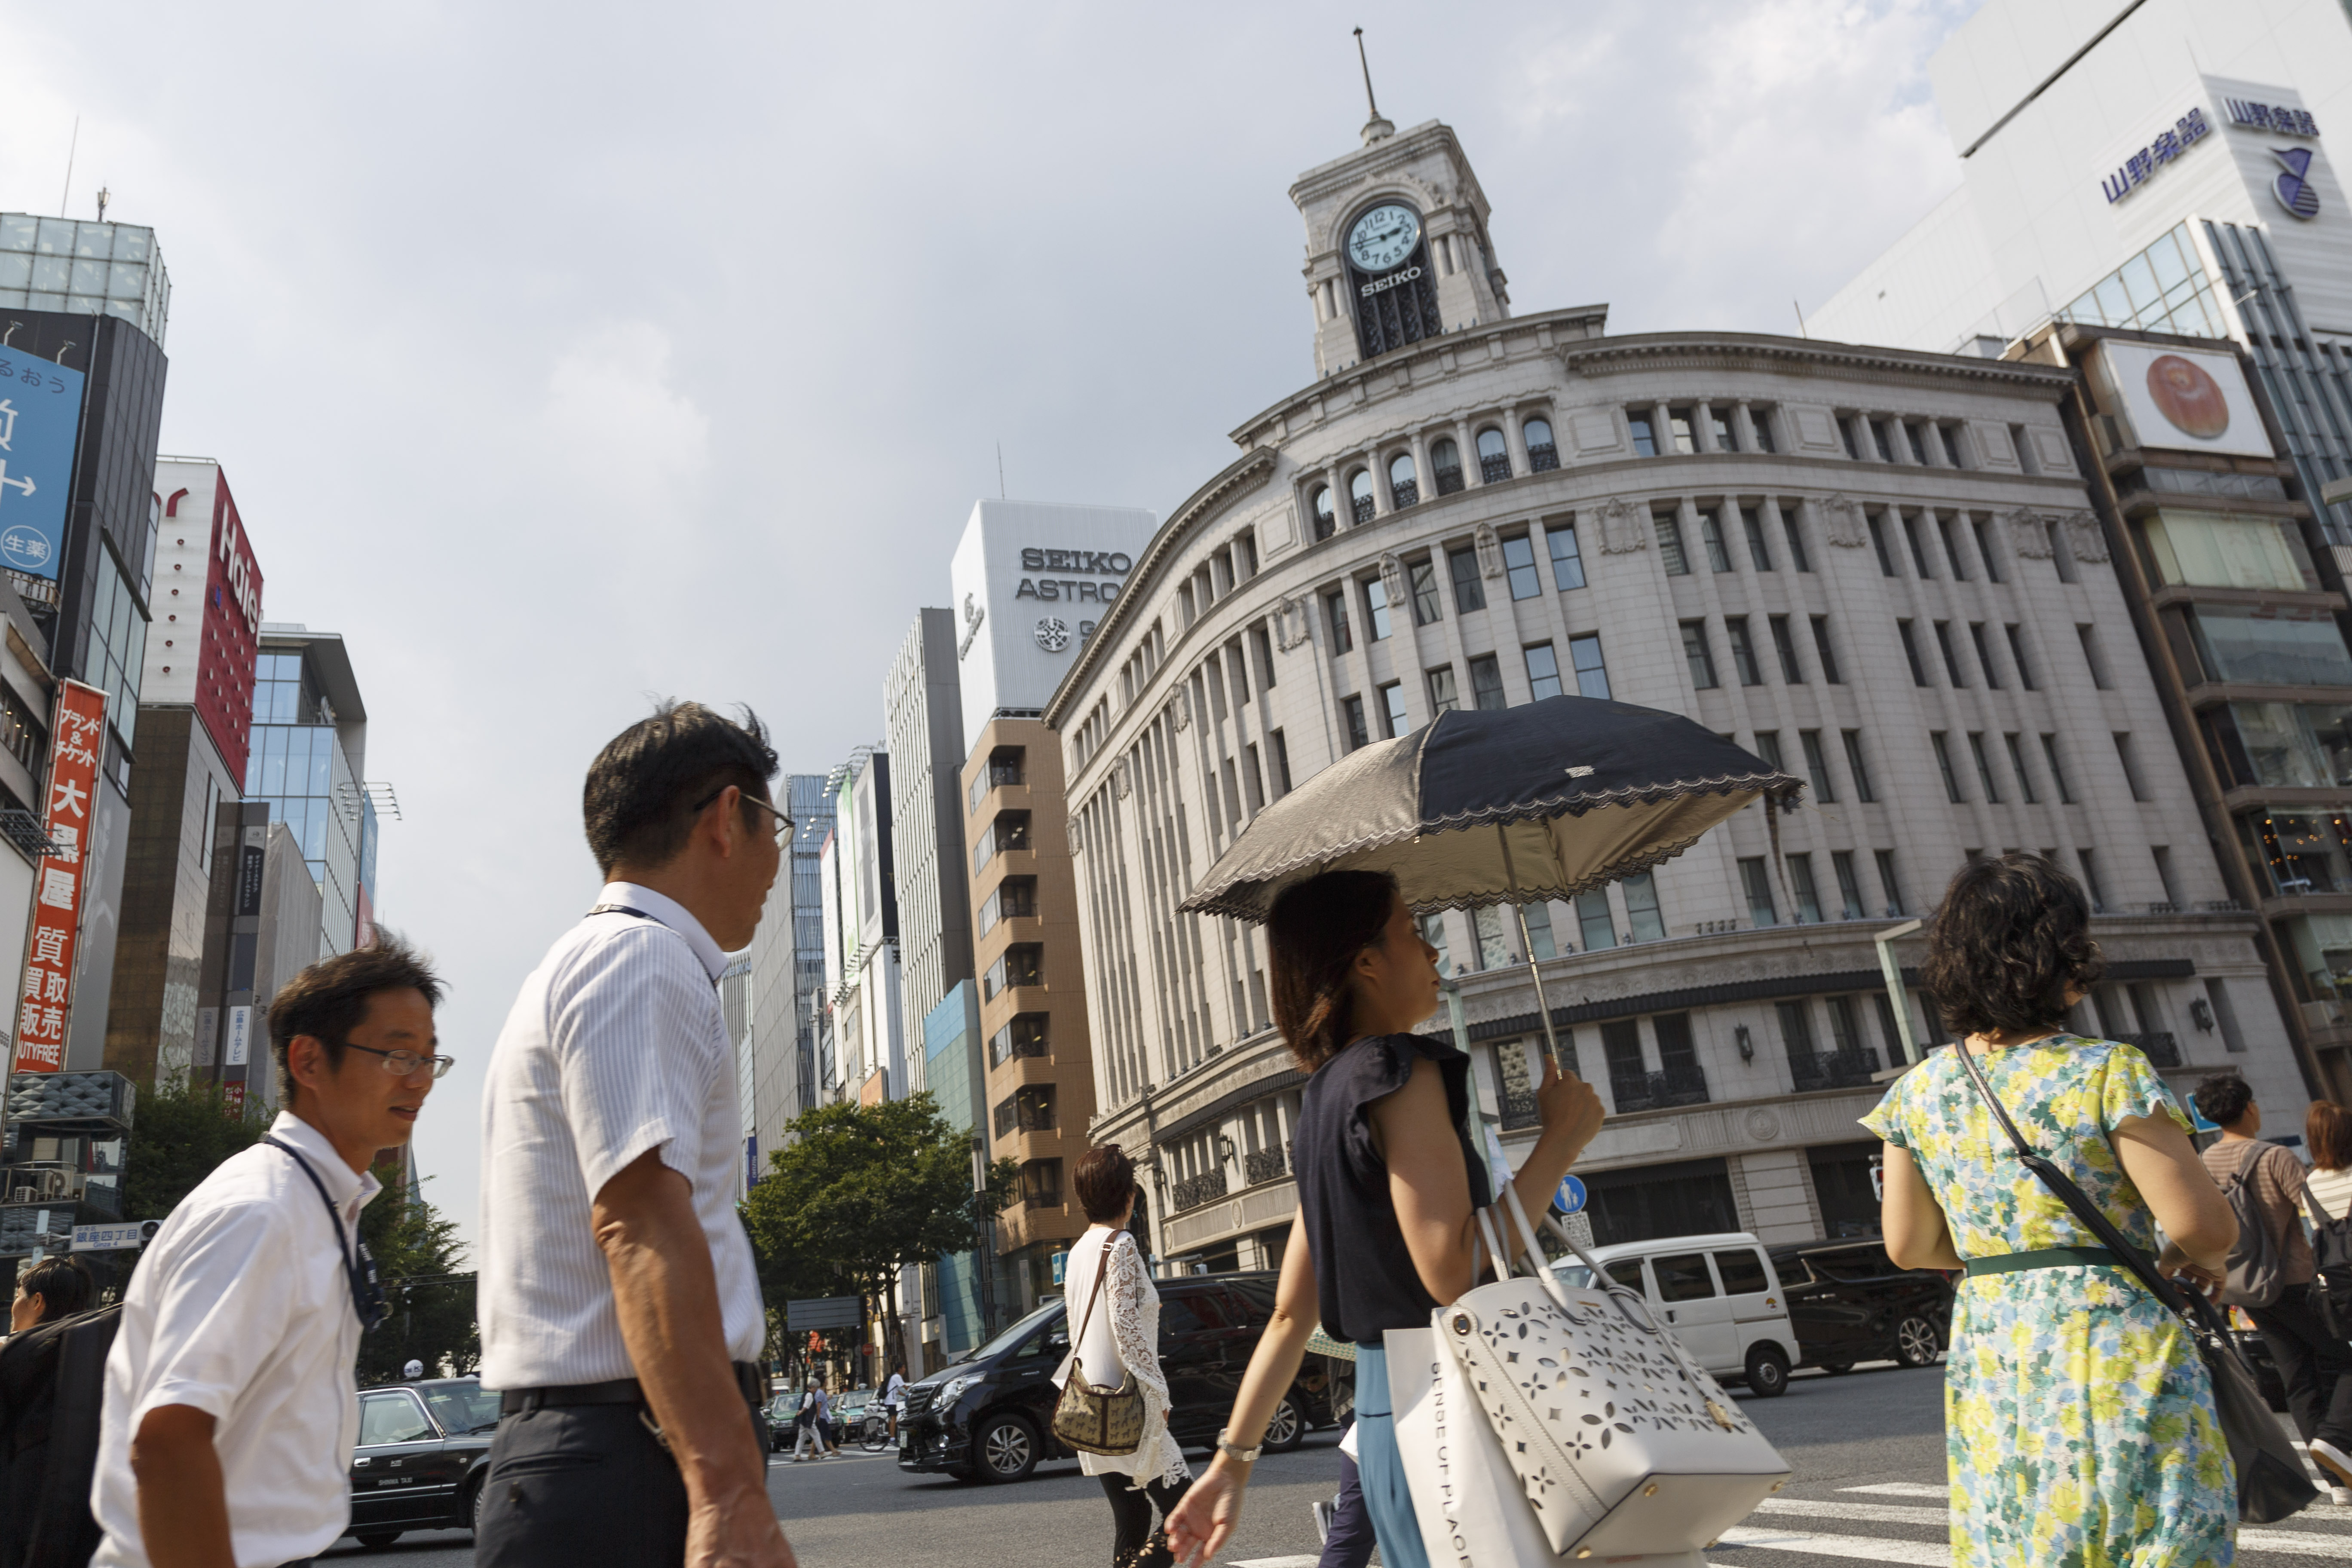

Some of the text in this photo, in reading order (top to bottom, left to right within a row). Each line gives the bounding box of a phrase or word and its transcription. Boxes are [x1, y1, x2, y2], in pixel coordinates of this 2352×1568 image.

[2222, 98, 2320, 137] 山野楽器
[2101, 107, 2207, 203] 山野楽器
[1398, 214, 1405, 224] 2
[1402, 236, 1409, 244] 4
[1362, 250, 1370, 261] 8
[1372, 253, 1380, 264] 7
[1383, 252, 1391, 263] 6
[1361, 266, 1421, 297] SEIKO
[1020, 548, 1133, 575] SEIKO
[70, 731, 83, 746] &
[40, 779, 87, 910] 大黒屋
[25, 966, 67, 1004] 買取
[21, 1002, 63, 1040] 販売
[76, 1229, 137, 1243] 銀座四丁目
